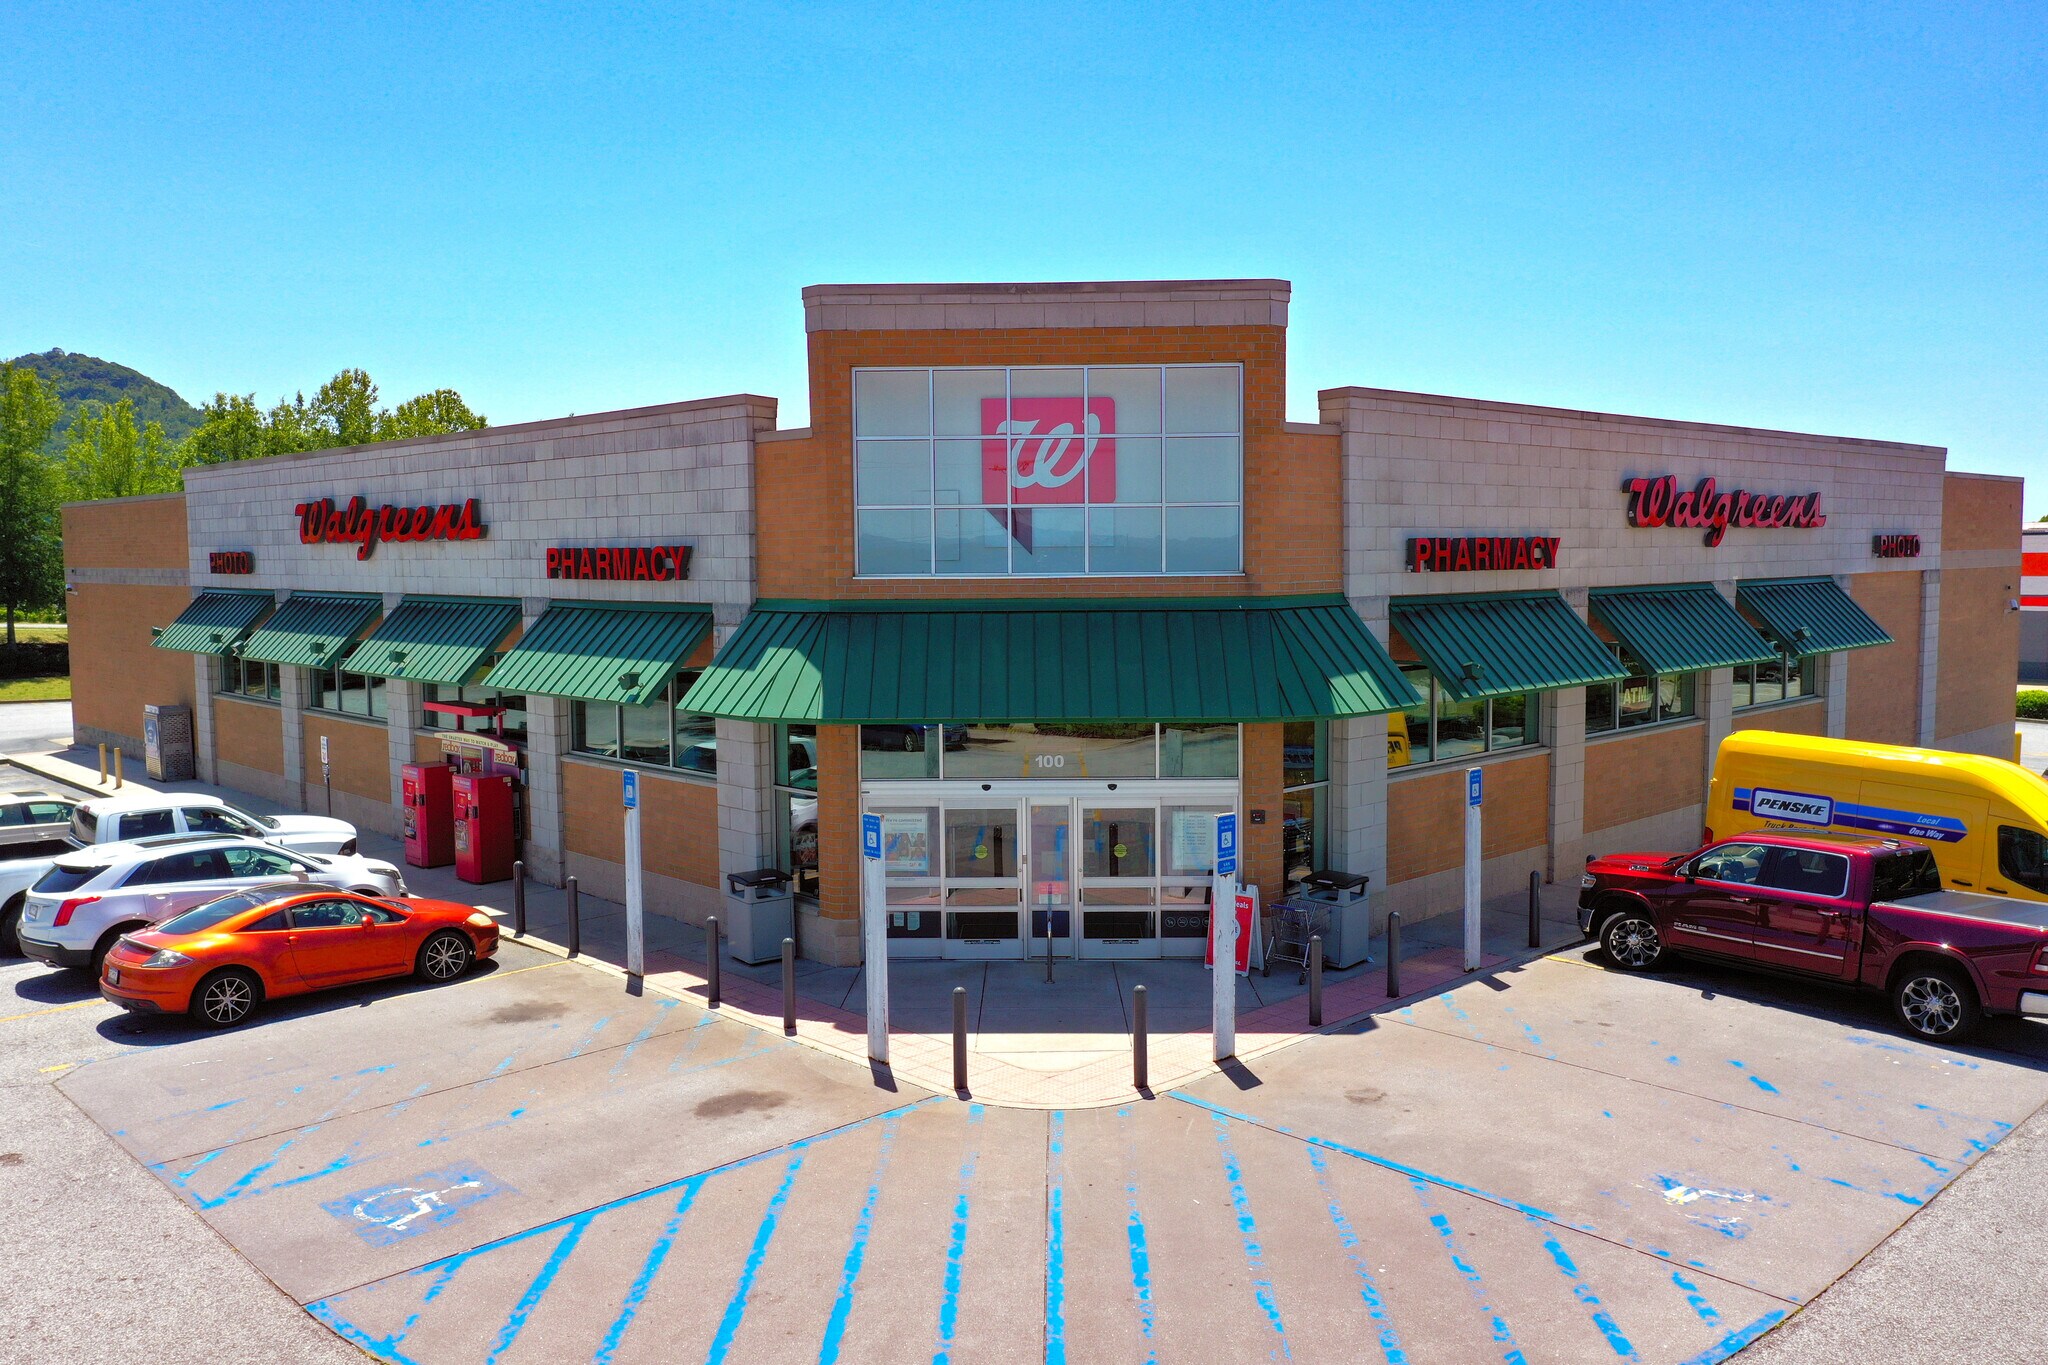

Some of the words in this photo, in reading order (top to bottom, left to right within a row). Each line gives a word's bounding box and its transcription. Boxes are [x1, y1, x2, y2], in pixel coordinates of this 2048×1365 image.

[1629, 475, 1827, 547] Walgreens
[295, 496, 482, 560] Walgreens
[1415, 536, 1560, 573] PHARMACY
[1879, 535, 1920, 558] PHOTO
[209, 551, 250, 574] PHOTO
[547, 546, 684, 581] PHARMACY
[1623, 686, 1648, 705] ATM
[495, 750, 516, 765] redbox
[1035, 755, 1065, 768] 100
[1757, 798, 1826, 816] PENSKE
[1917, 816, 1941, 825] Local
[1909, 827, 1925, 836] One
[1926, 829, 1945, 840] Way
[1235, 901, 1249, 909] eals
